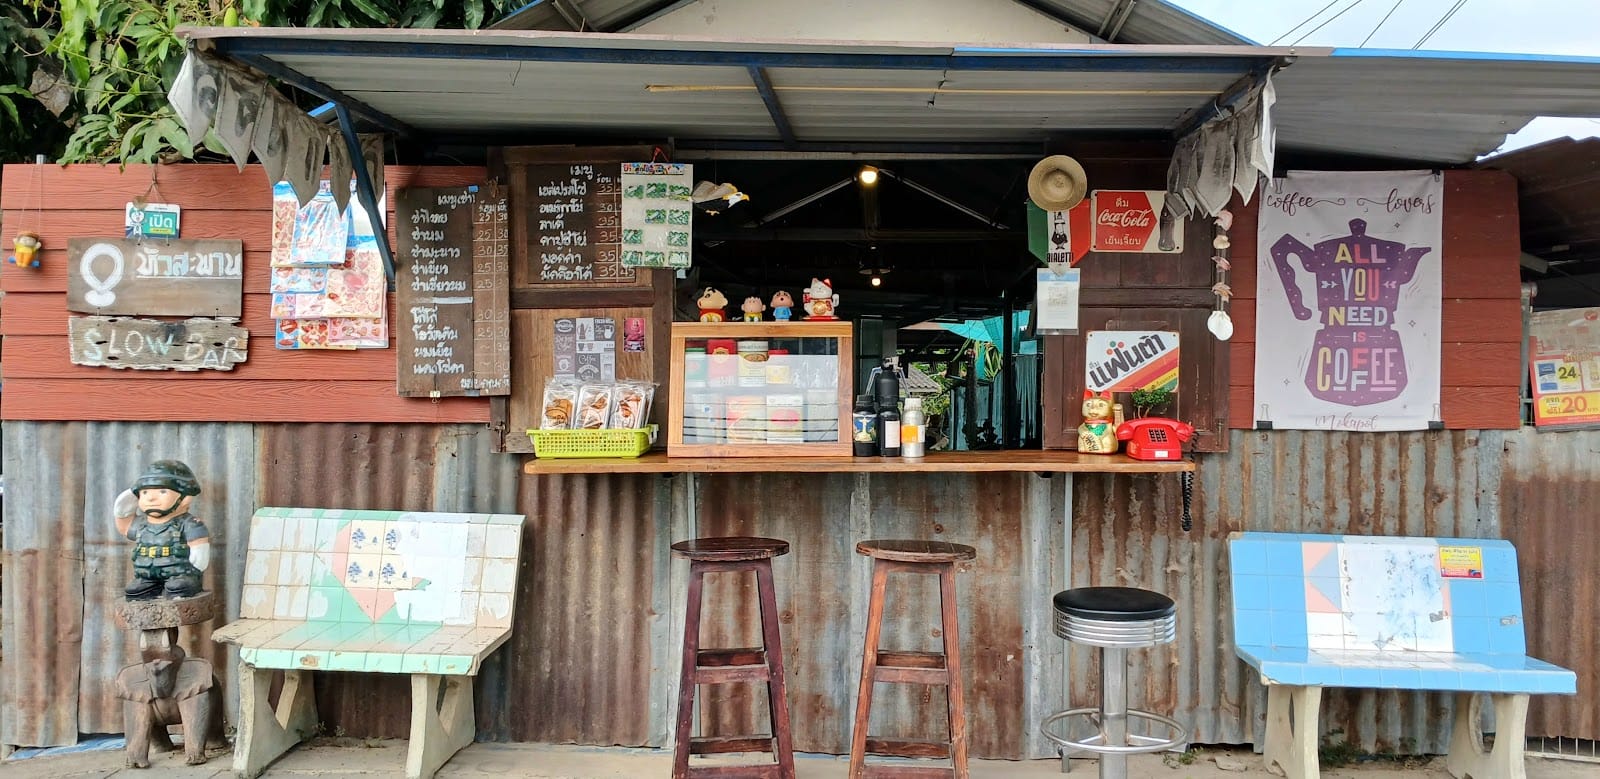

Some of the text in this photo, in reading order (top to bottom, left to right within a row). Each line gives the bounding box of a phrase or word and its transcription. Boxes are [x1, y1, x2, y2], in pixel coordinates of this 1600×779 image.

[570, 165, 593, 180] เมนู
[600, 184, 614, 193] 35
[600, 203, 613, 212] 30
[1374, 188, 1434, 214] lovers
[149, 213, 173, 228] เปิด
[479, 212, 493, 222] 25
[598, 216, 616, 226] 35
[1097, 208, 1152, 227] Coca-Cola
[411, 226, 444, 241] ชานม
[477, 228, 492, 240] 25
[600, 231, 616, 243] 35
[478, 246, 493, 255] 30
[496, 245, 509, 255] 35
[599, 250, 616, 262] 35
[1335, 243, 1386, 263] ALL
[1047, 252, 1074, 263] BIALETTI
[477, 263, 493, 273] 25
[600, 264, 616, 277] 35
[477, 279, 493, 289] 25
[1341, 268, 1380, 301] YOU
[1328, 306, 1388, 326] NEED
[1353, 331, 1367, 342] IS
[83, 328, 246, 367] SLOW BAR
[1316, 347, 1398, 392] COFFEE
[1561, 395, 1587, 413] 20
